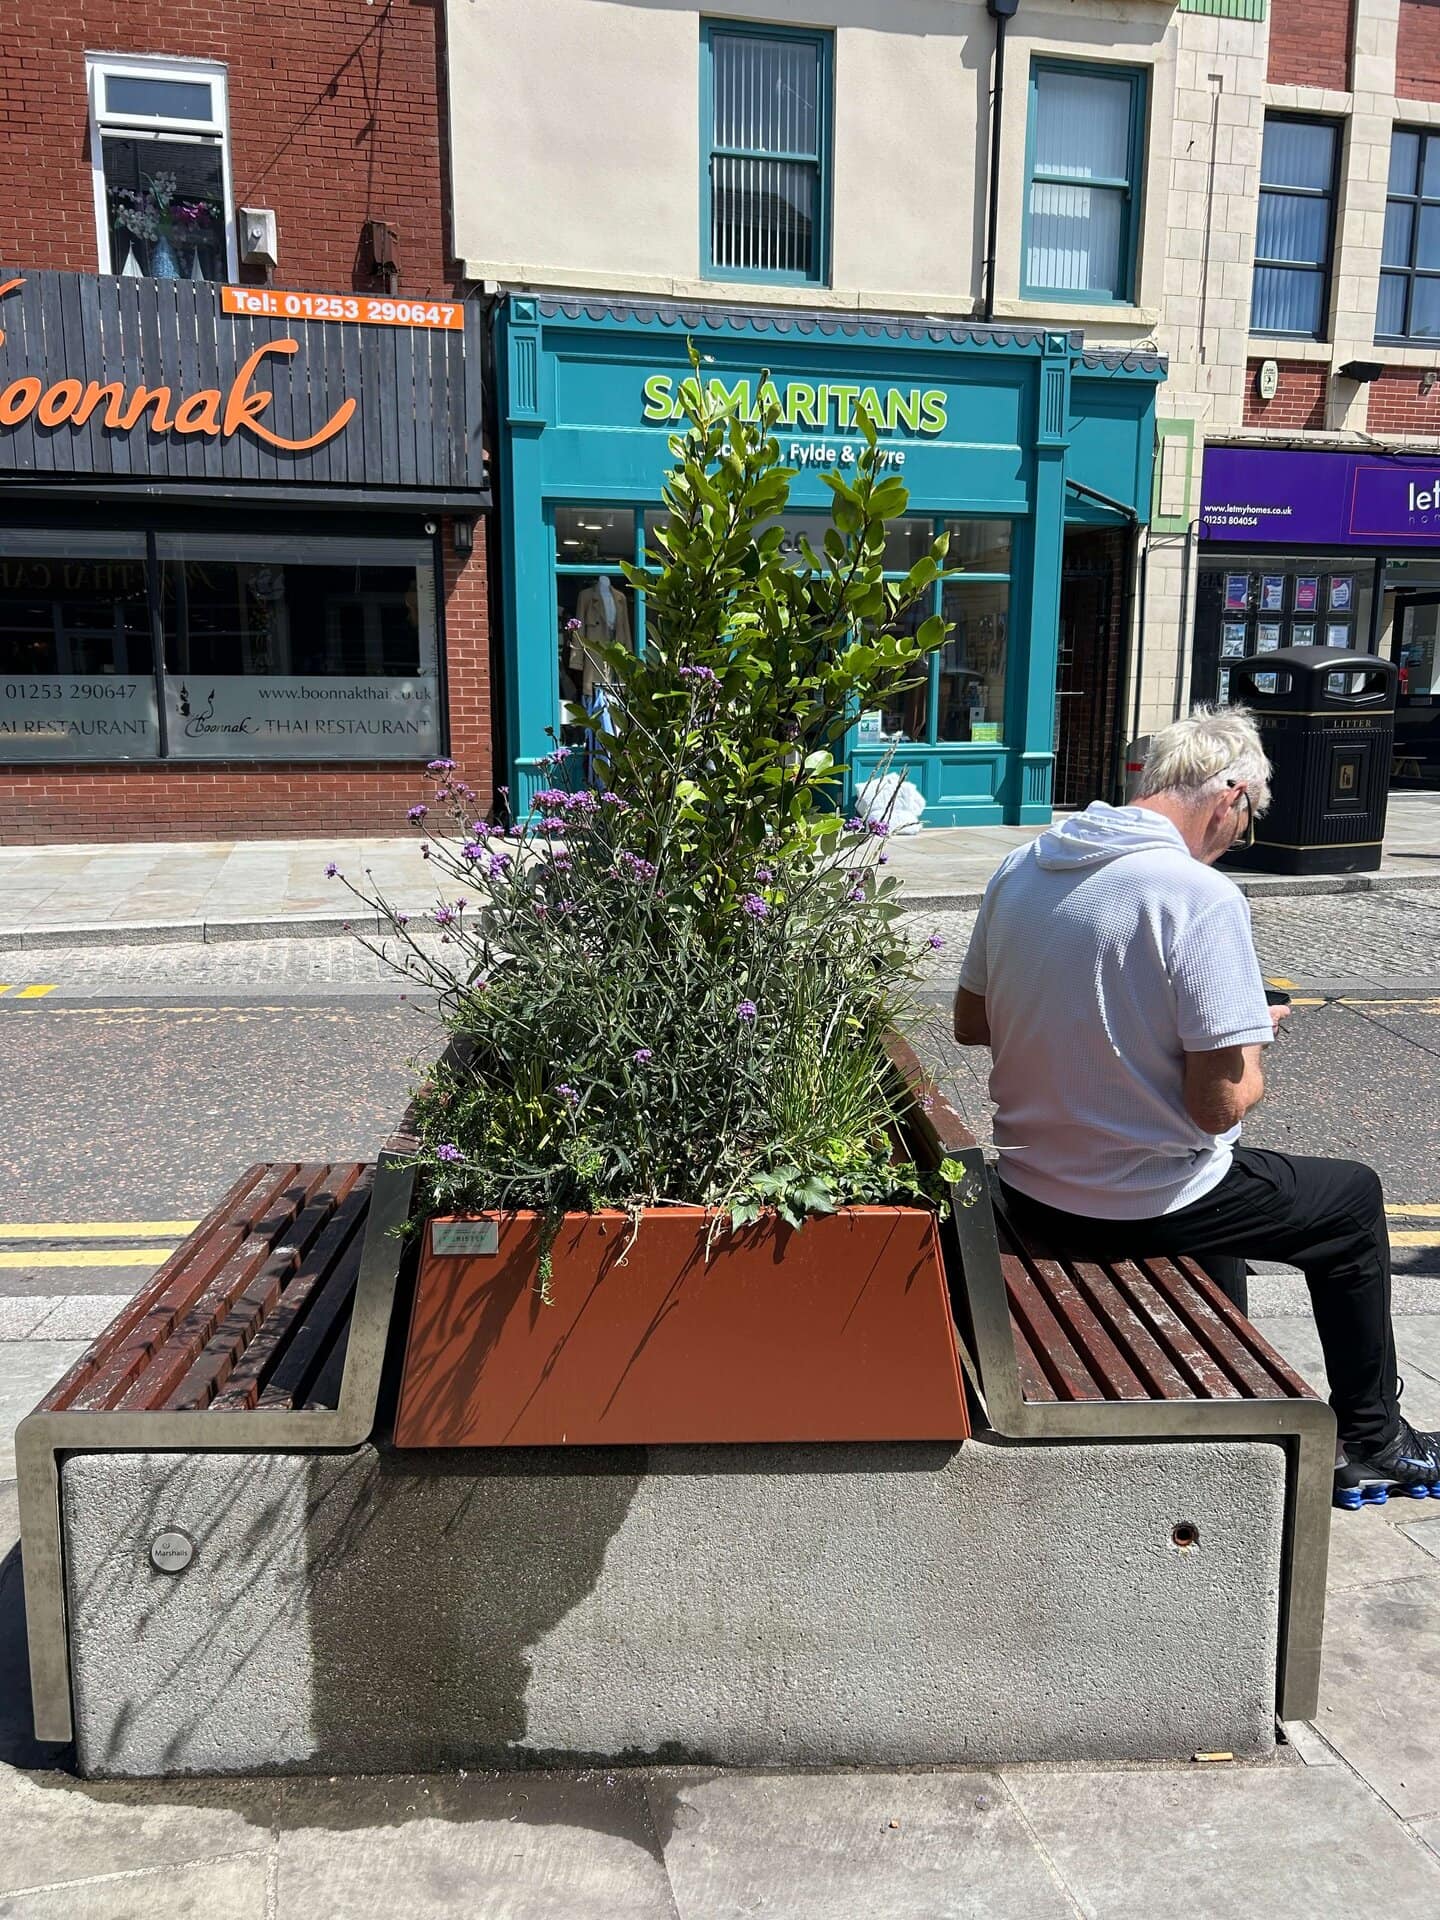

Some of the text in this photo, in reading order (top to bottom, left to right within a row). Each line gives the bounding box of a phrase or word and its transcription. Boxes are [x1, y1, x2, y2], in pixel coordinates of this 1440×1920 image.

[231, 290, 455, 325] Tel: 01253 290647
[643, 374, 948, 433] SAMARITANS
[790, 442, 836, 464] Fylde
[840, 444, 856, 463] &
[1204, 503, 1292, 515] www.letmyhomes.co.uk
[1203, 515, 1258, 526] 01253 804054
[5, 683, 137, 700] 01253 290647
[24, 719, 150, 736] RESTAURANT
[264, 719, 309, 735] THAI
[315, 719, 431, 735] RESTAURANT
[1333, 719, 1372, 729] LITTER
[154, 1549, 188, 1557] Marshalls
